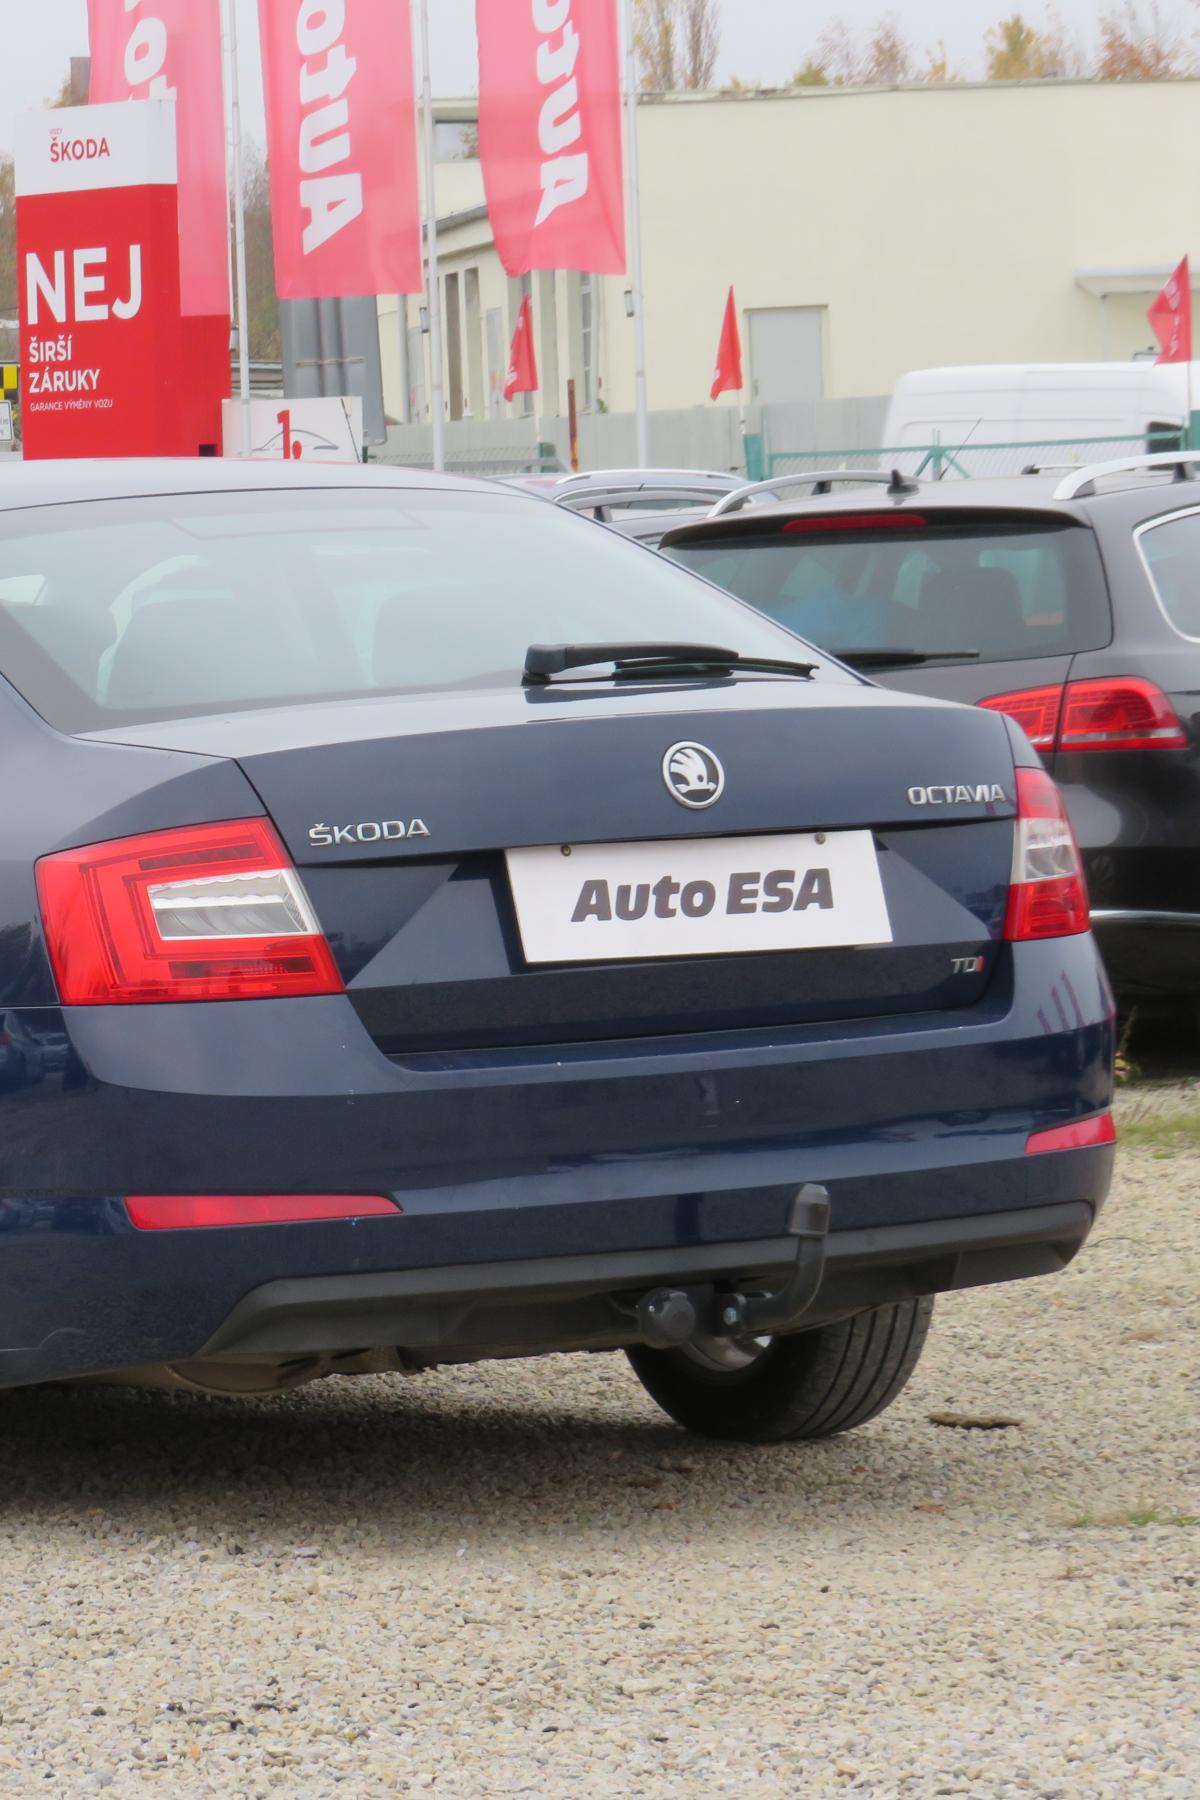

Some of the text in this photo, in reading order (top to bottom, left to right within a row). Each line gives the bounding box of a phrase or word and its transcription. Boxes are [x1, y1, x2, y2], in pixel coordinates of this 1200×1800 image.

[296, 0, 364, 256] Auto
[50, 136, 110, 163] ŠKODA
[26, 244, 142, 325] NEJ
[29, 334, 72, 363] ŠIRŠÍ
[29, 366, 100, 394] ZÁRUKY
[30, 401, 63, 412] GARANCE
[95, 399, 113, 409] VOZU
[277, 409, 303, 460] 1.
[907, 784, 1006, 806] OCTAVIA
[308, 818, 432, 847] ŠKODA
[570, 867, 835, 923] Auto ESA
[950, 955, 985, 976] TDI
